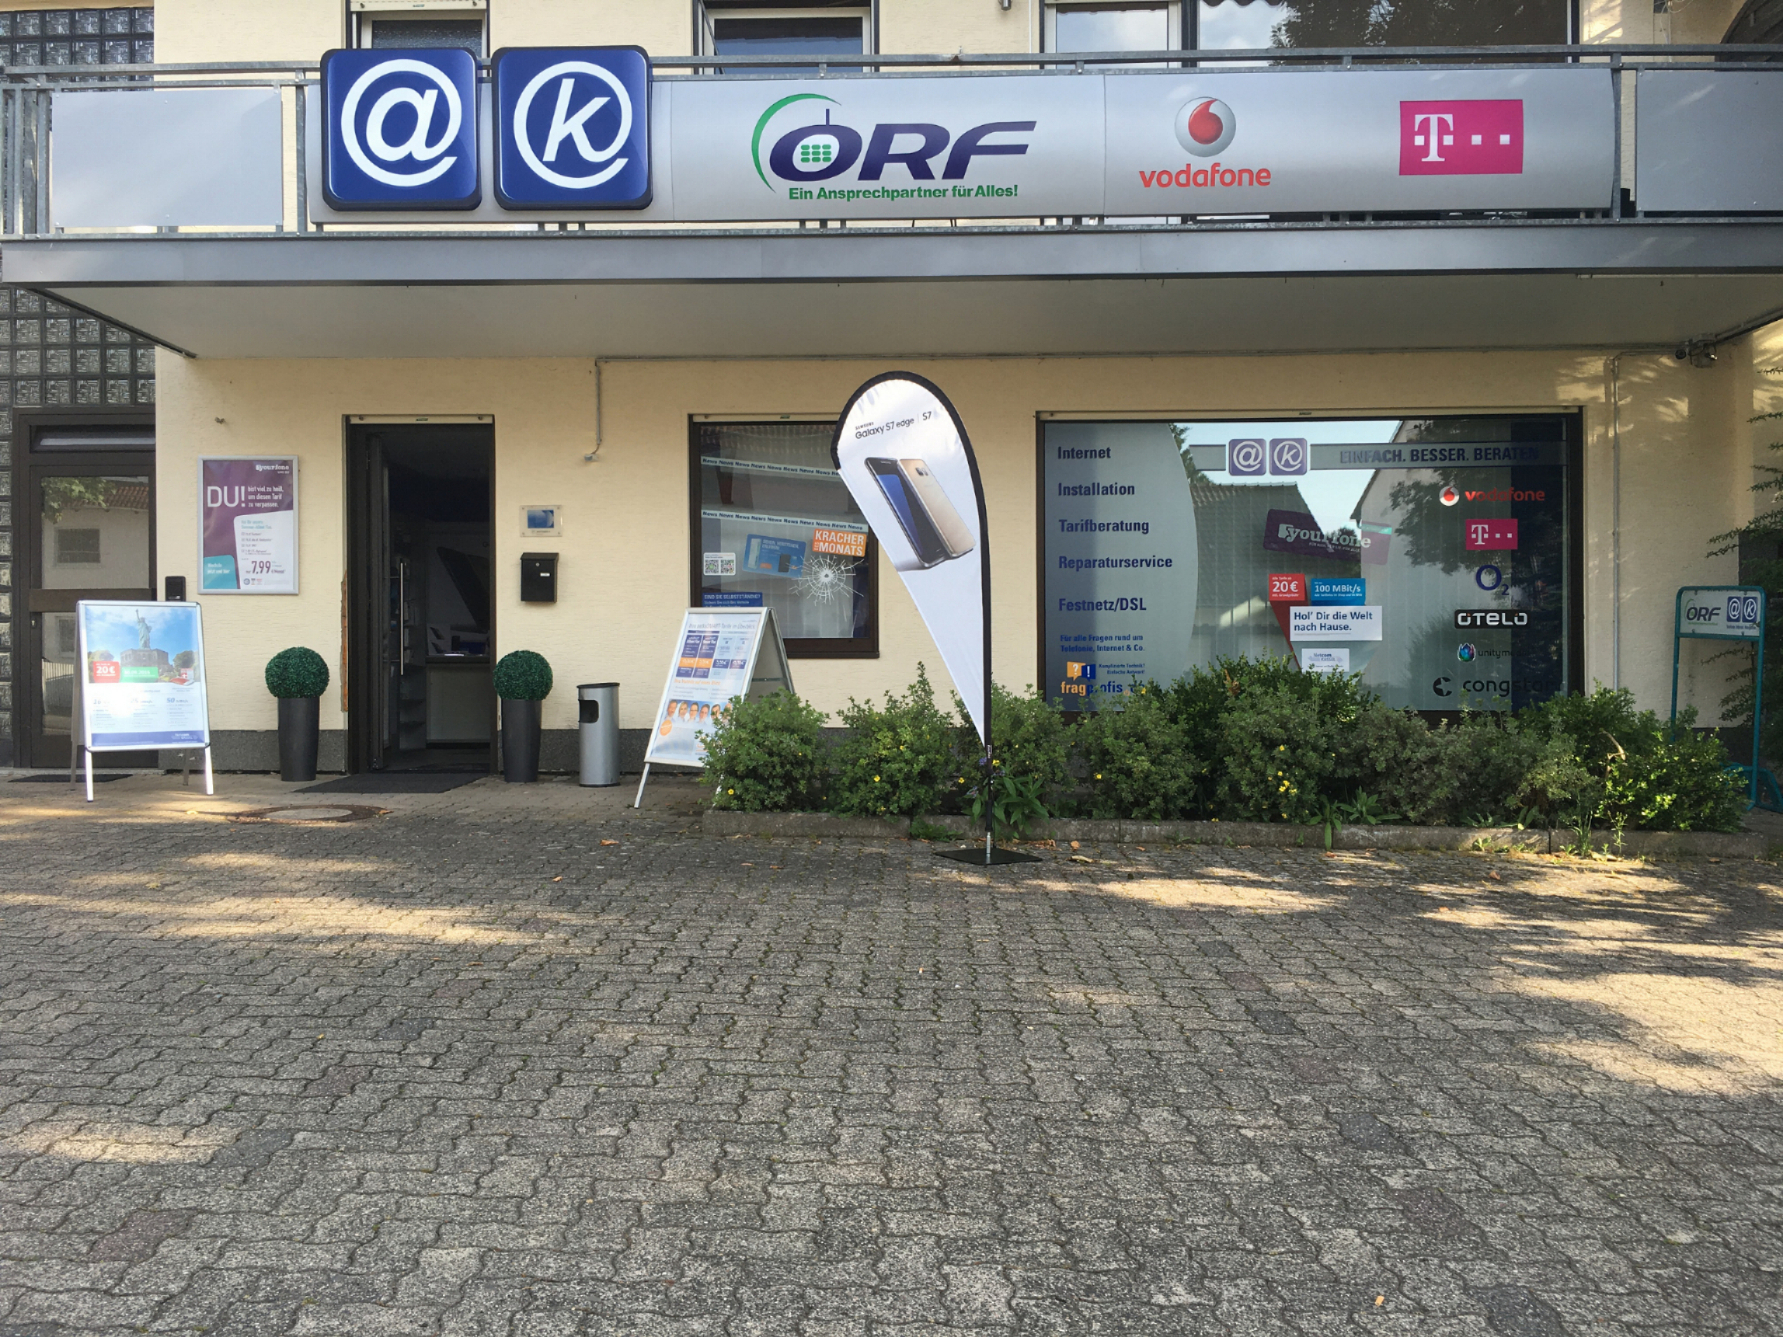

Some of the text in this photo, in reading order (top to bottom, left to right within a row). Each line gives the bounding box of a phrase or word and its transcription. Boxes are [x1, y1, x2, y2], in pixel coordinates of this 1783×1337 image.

[341, 58, 462, 187] @
[769, 121, 1037, 182] ORF
[1139, 162, 1272, 188] vodafone
[788, 185, 1018, 202] Ein Ansprechpartner für Alles!
[855, 411, 932, 439] Galaxy S7 edge S7
[1057, 446, 1111, 459] Internet
[1233, 440, 1263, 472] @
[1340, 450, 1406, 464] EINFACH.
[1410, 448, 1469, 462] BESSER.
[207, 486, 245, 507] DU!
[1058, 482, 1135, 496] Installation
[1465, 486, 1545, 501] vodafone
[1058, 519, 1149, 535] Tarifberatung
[815, 530, 865, 545] KRACHER
[819, 542, 863, 556] MONATS
[251, 560, 271, 575] 7,99
[1058, 555, 1173, 572] Reparaturservice
[1314, 584, 1361, 593] 100 MBit/s
[1058, 597, 1147, 612] Festnetz/DSL
[1316, 611, 1330, 620] Dir
[1332, 611, 1348, 620] die
[1350, 611, 1373, 620] Welt
[1686, 607, 1722, 621] ORF
[1294, 623, 1352, 631] nach Hause.
[1088, 634, 1113, 643] Fragen
